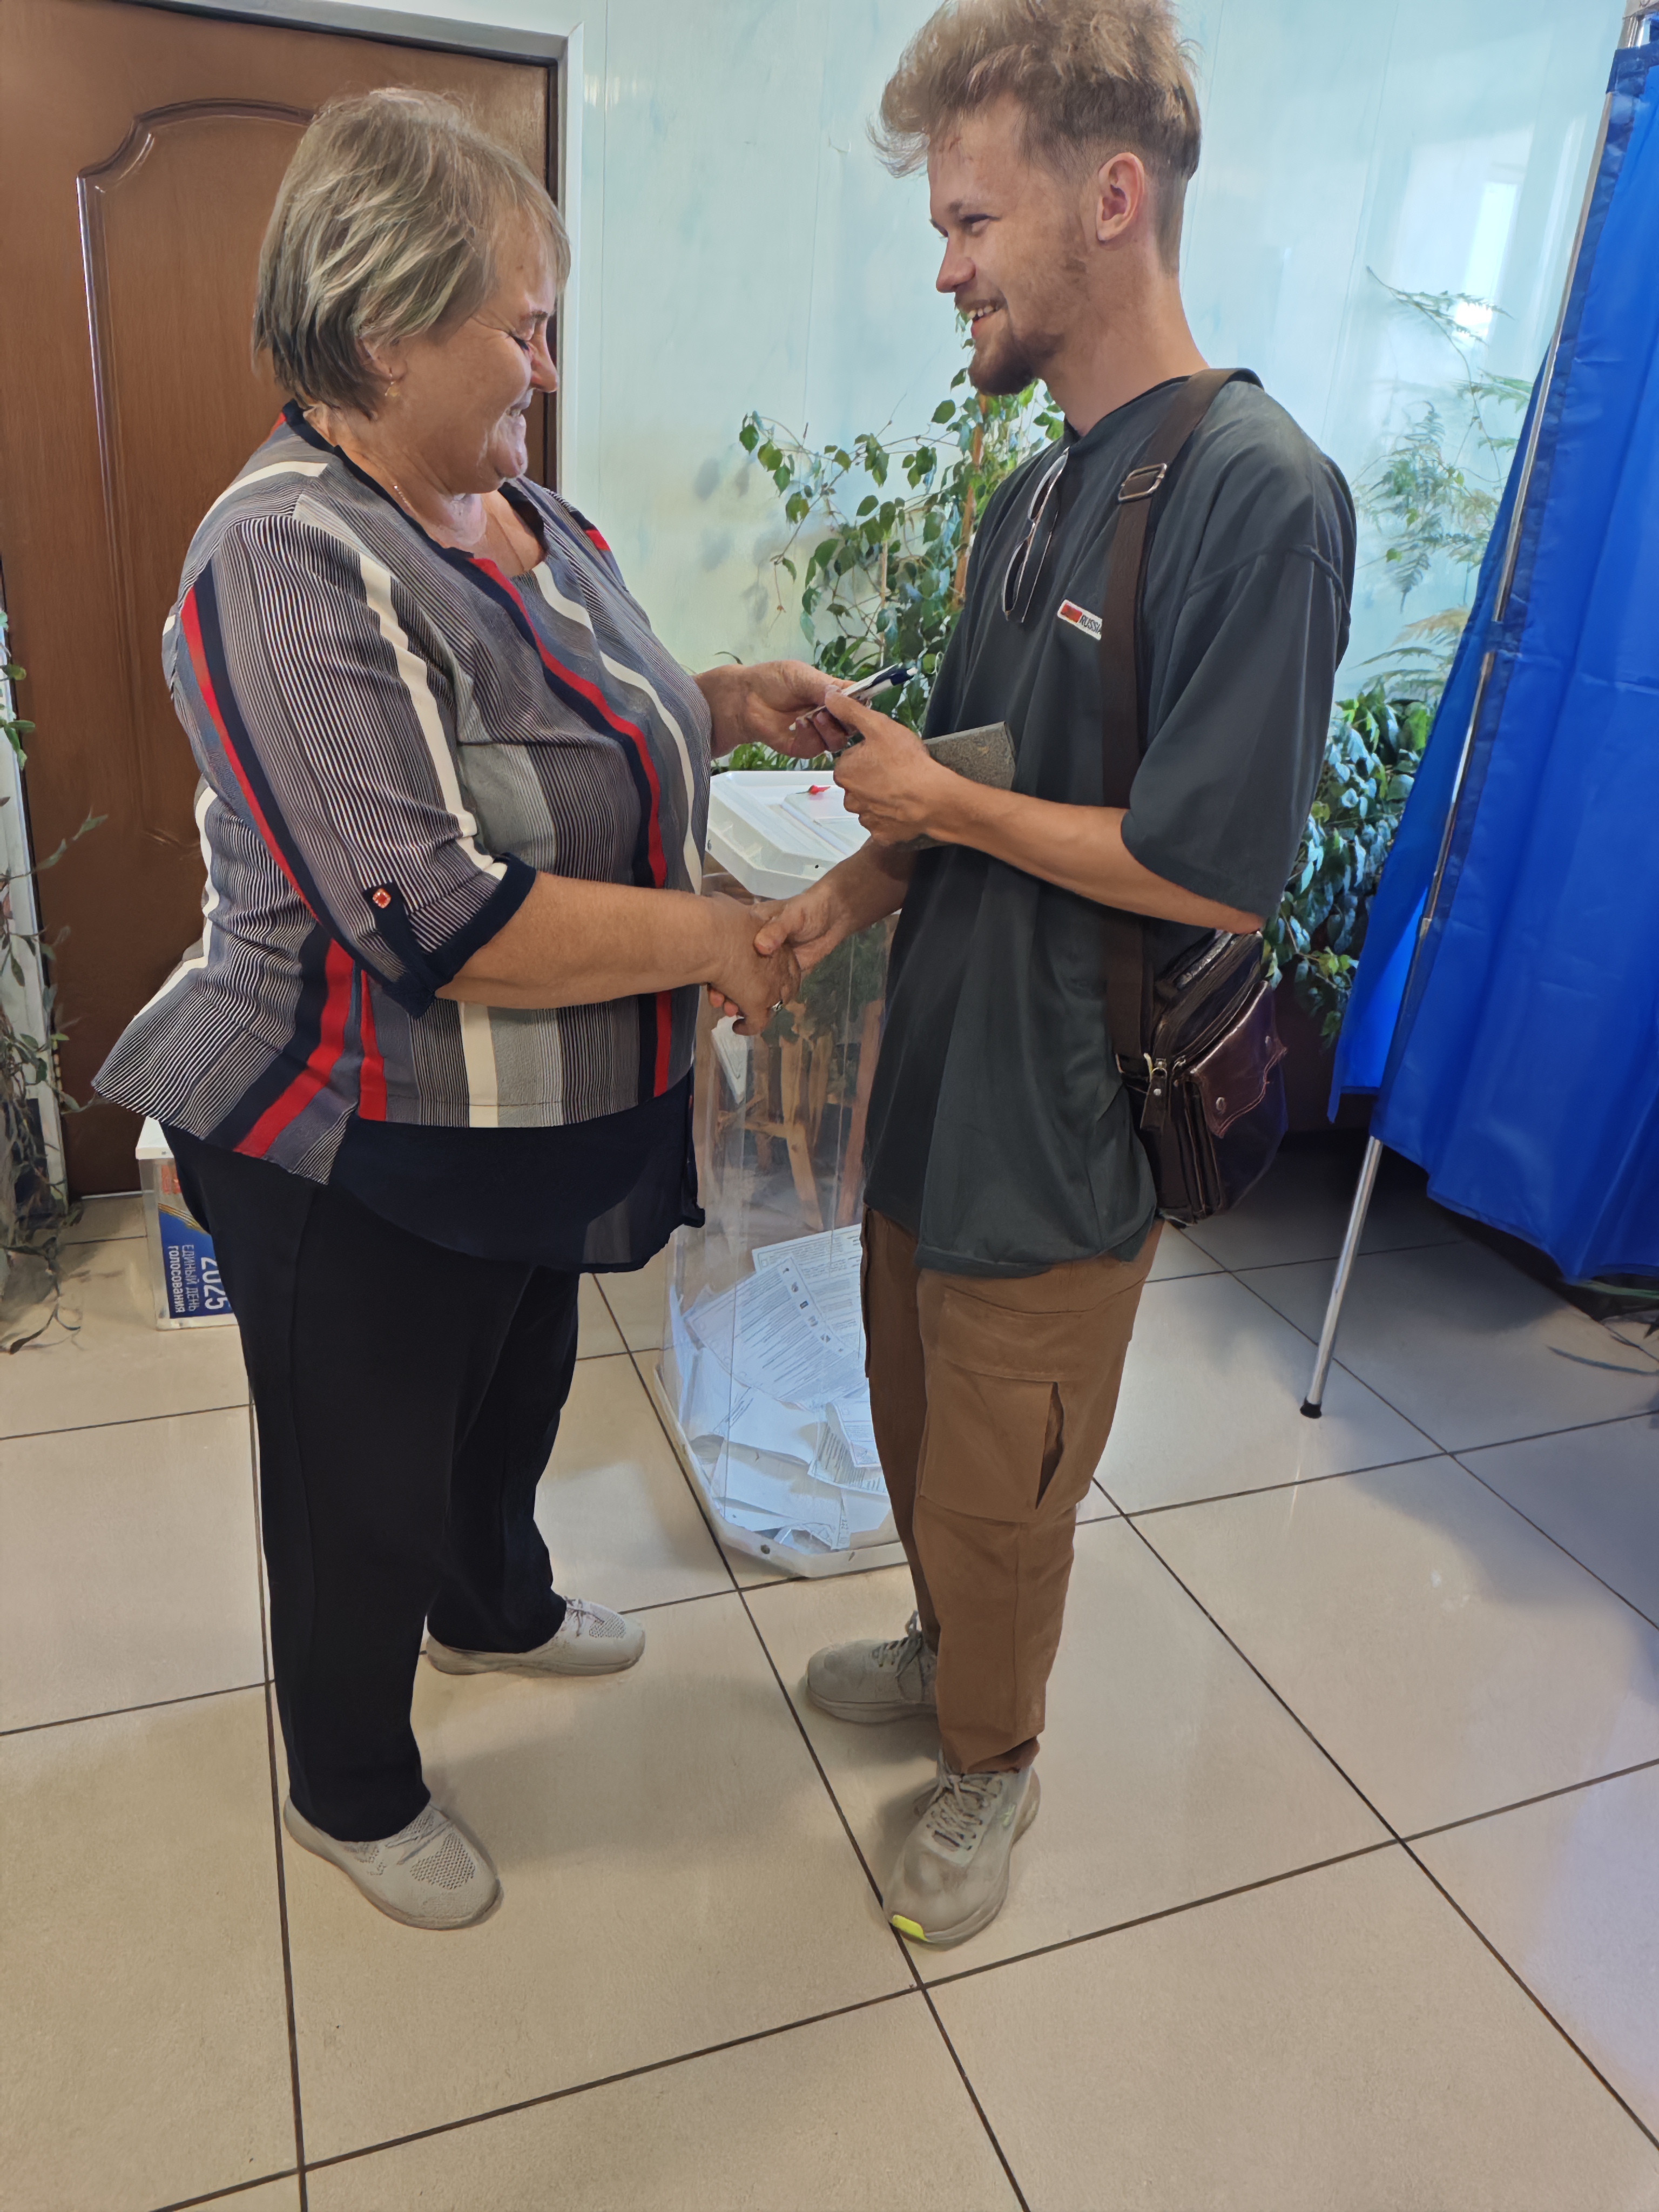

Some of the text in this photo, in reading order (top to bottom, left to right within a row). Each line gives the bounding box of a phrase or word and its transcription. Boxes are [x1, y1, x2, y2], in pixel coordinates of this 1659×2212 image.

[168, 1245, 185, 1313] голосования
[182, 1245, 199, 1312] ЕДИНЫЙ ДЕНЬ
[201, 1257, 230, 1310] 2025
